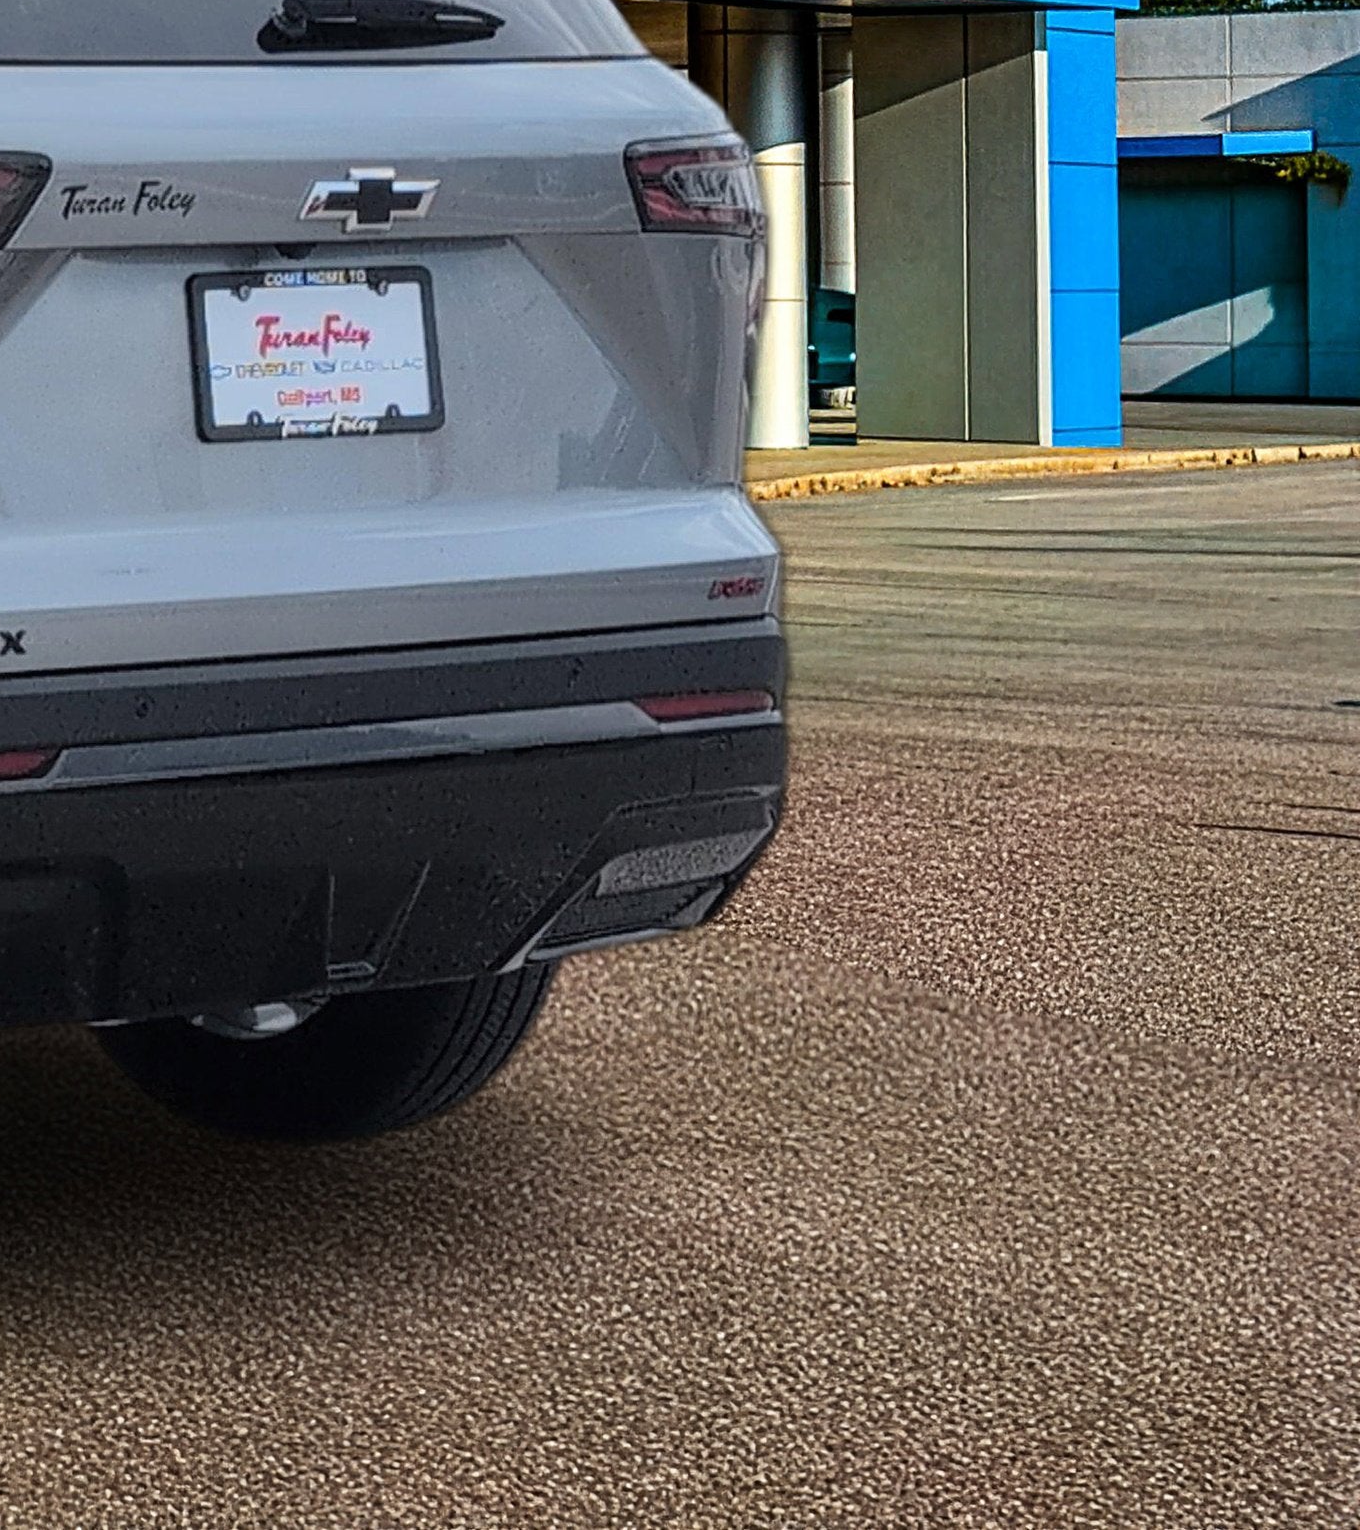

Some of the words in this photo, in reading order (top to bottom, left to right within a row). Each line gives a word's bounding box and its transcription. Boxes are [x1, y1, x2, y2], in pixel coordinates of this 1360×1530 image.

[60, 184, 126, 220] Turan
[132, 180, 197, 218] Foley
[255, 316, 321, 358] Turan
[322, 314, 371, 358] Foley
